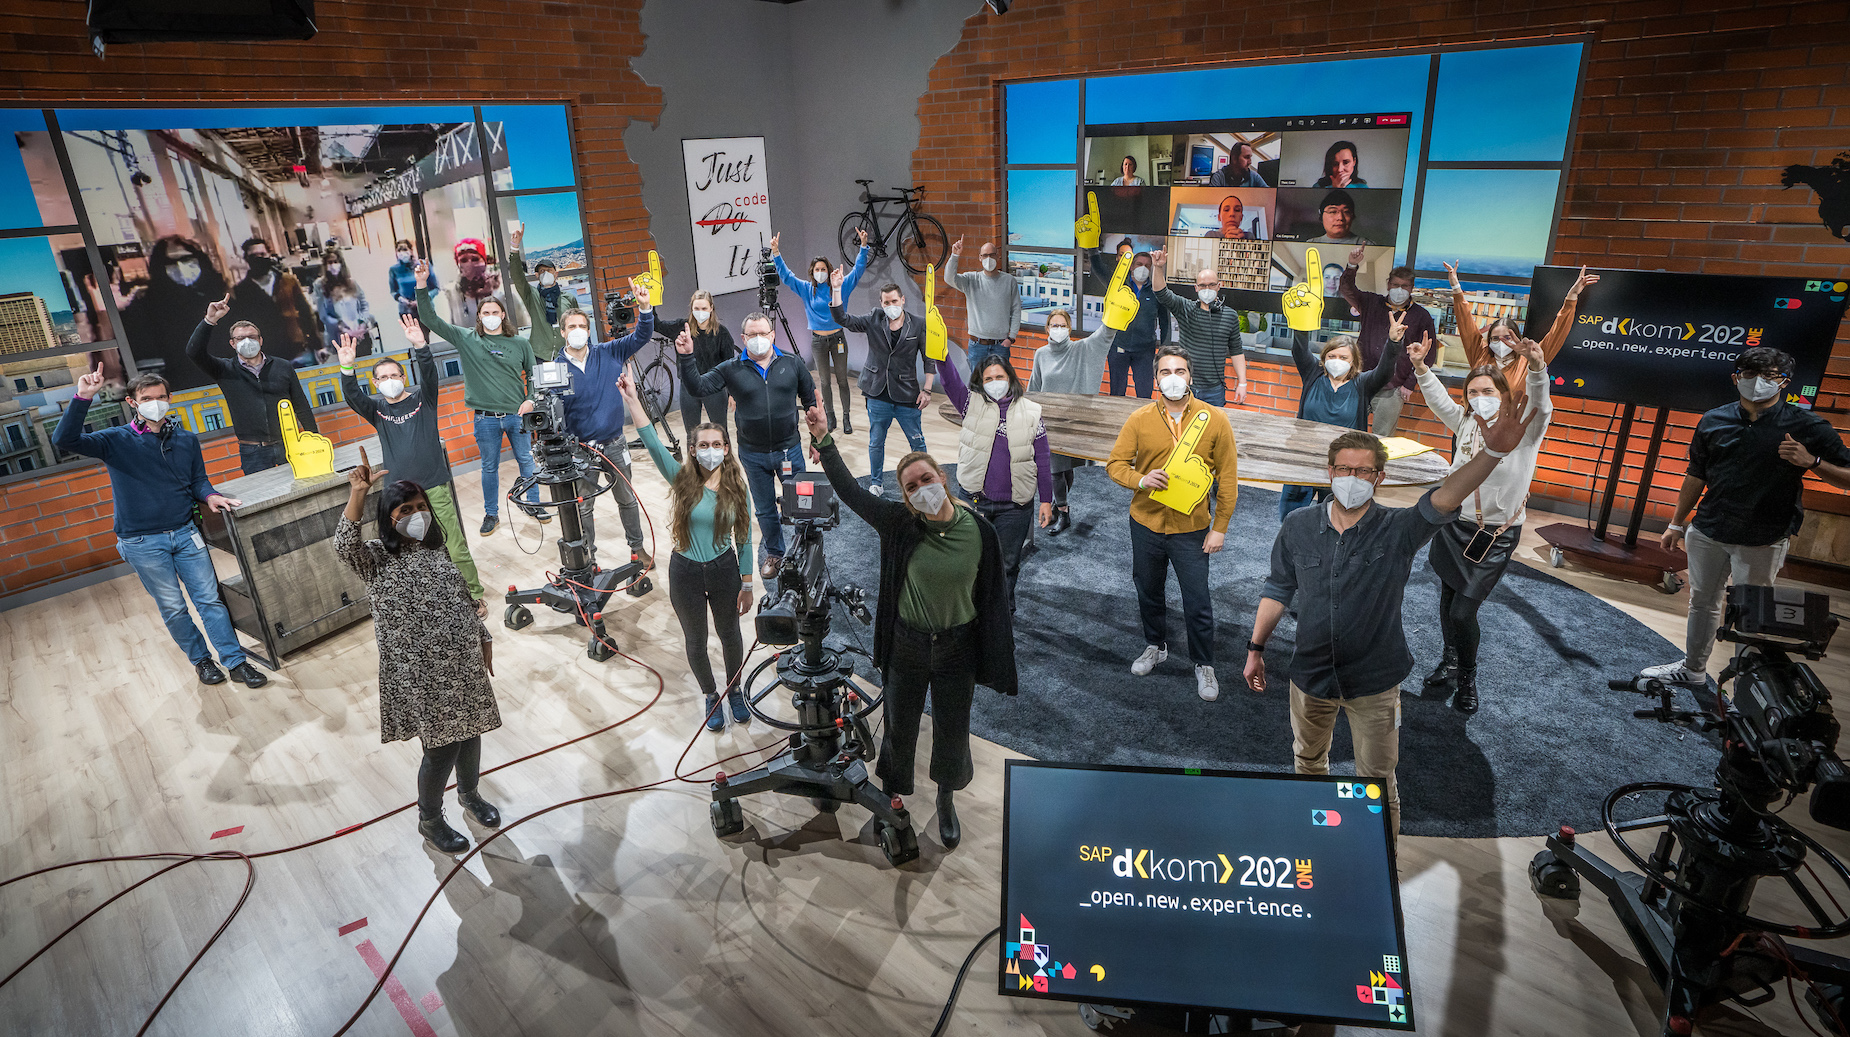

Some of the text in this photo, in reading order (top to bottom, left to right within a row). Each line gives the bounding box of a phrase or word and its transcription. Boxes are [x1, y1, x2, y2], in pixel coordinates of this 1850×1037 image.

[696, 152, 755, 191] Just
[735, 192, 767, 207] code
[725, 244, 753, 278] It
[1578, 314, 1603, 326] SAP
[1698, 324, 1746, 346] 202
[1746, 327, 1764, 347] ONE
[1573, 340, 1740, 362] _open.new.experienc
[1079, 845, 1113, 862] SAP
[1238, 855, 1295, 889] 202
[1295, 858, 1314, 889] ONE
